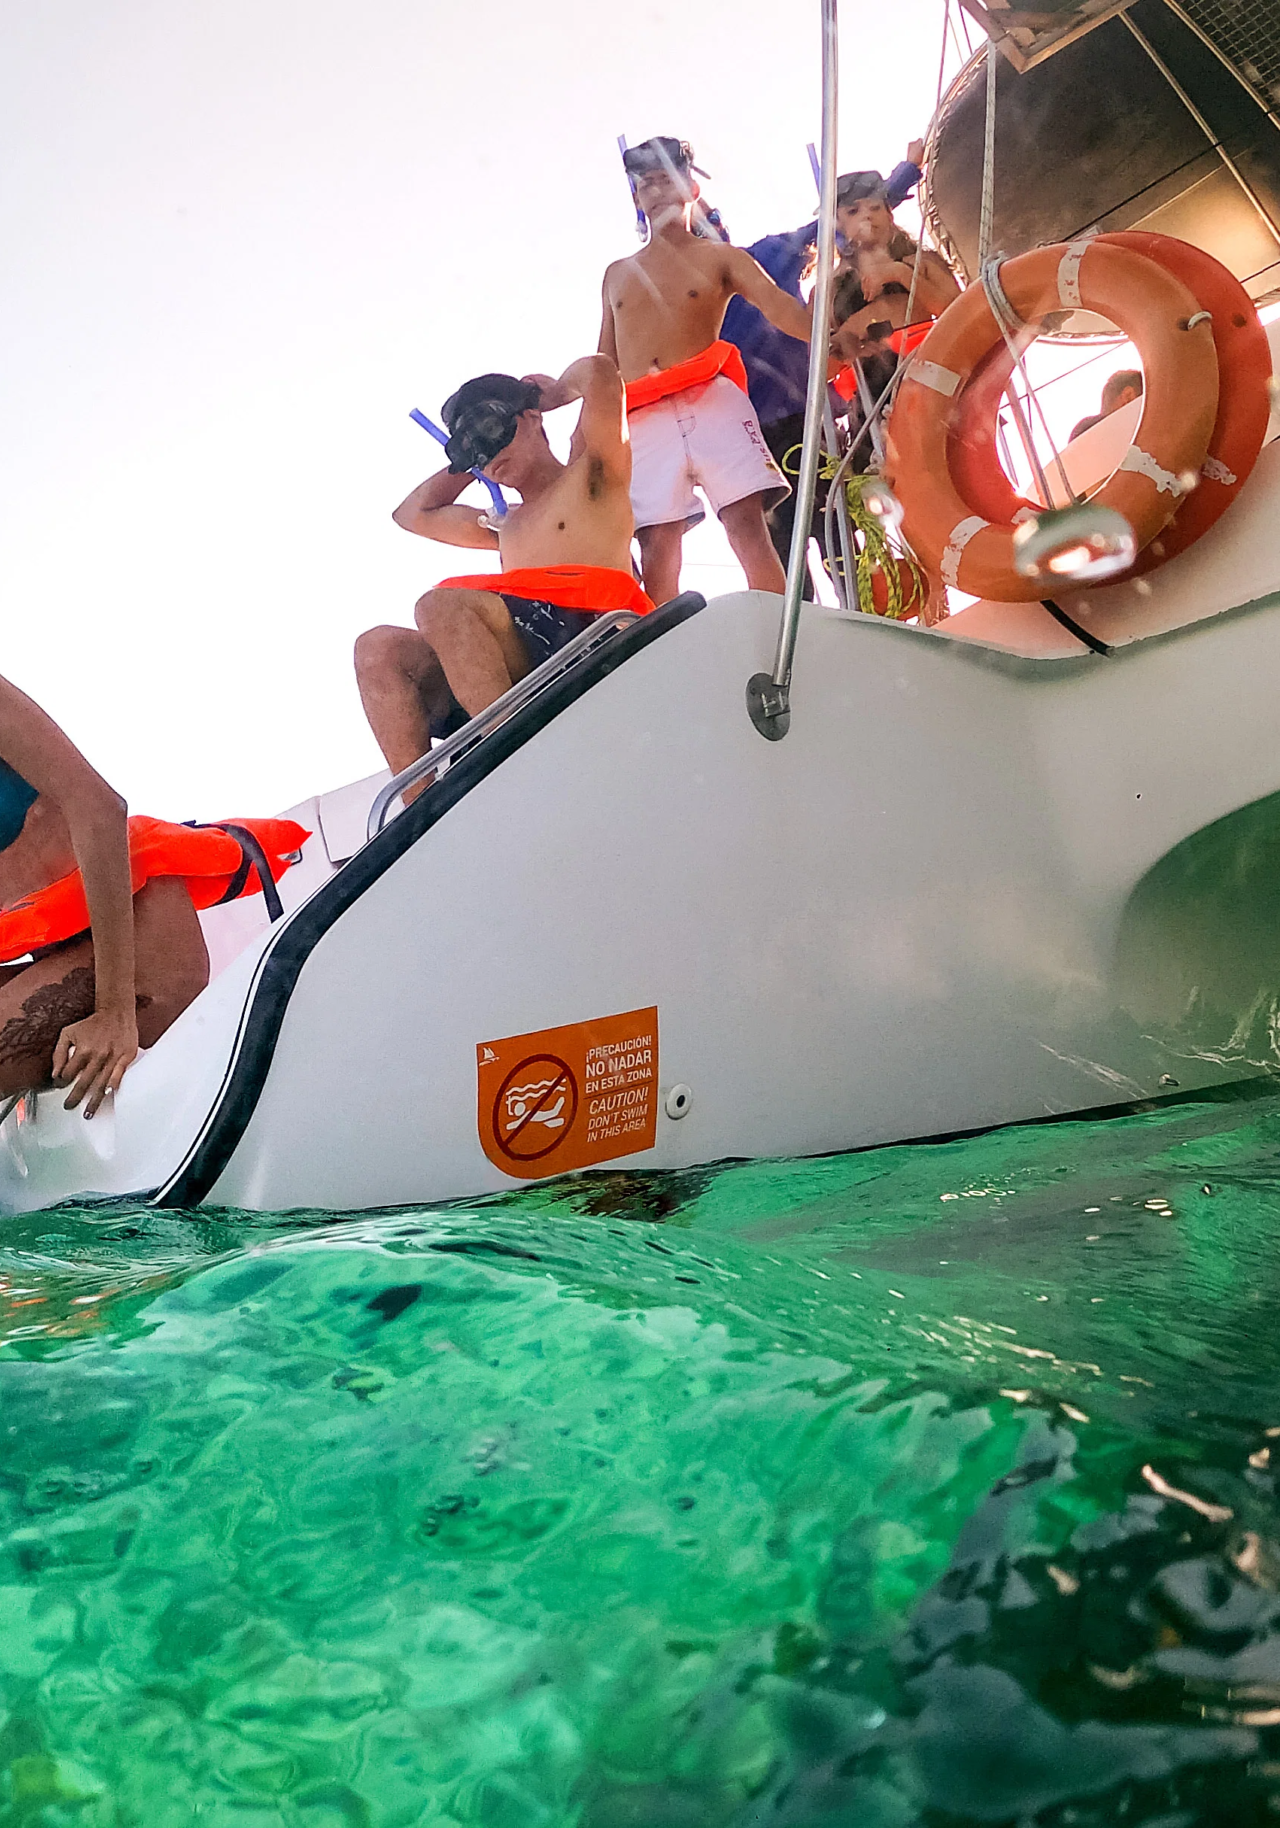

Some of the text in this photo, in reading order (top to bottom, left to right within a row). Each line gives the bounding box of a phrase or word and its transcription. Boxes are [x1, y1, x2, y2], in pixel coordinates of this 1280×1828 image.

[586, 1035, 652, 1063] ¡PRECAUCIÓN!
[586, 1049, 652, 1078] NO NADAR
[585, 1067, 652, 1093] EN ESTA ZONA
[589, 1086, 649, 1115] CAUTION!
[587, 1117, 646, 1143] IN THIS AREA
[588, 1103, 648, 1130] DON'T SWIM
